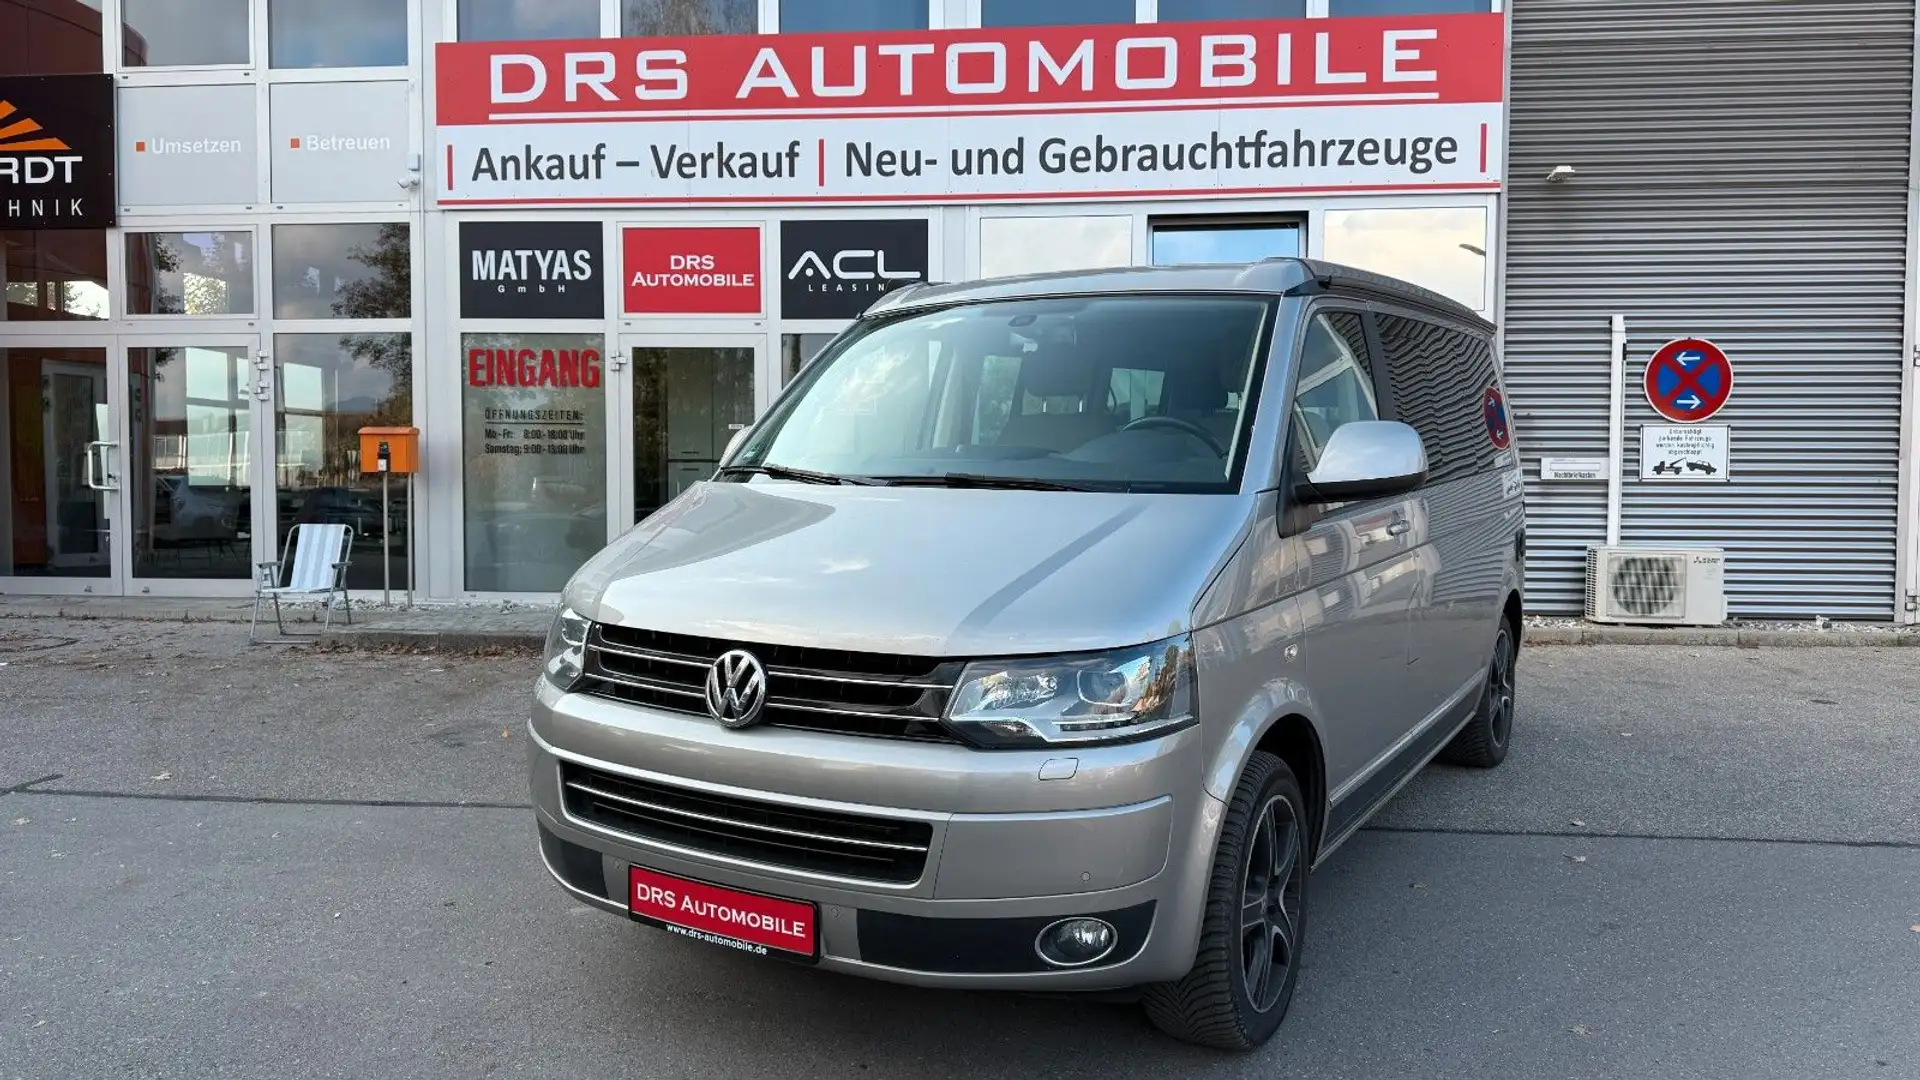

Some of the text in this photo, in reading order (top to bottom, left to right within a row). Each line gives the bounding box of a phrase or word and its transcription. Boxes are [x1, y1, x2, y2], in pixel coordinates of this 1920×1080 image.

[489, 28, 1438, 103] DRS AUTOMOBILE
[151, 136, 242, 154] Umsetzen
[306, 133, 391, 151] Betreuen
[846, 129, 1459, 177] Neu- und Gebrauchtfahrzeuge
[0, 156, 83, 184] RDT
[472, 142, 607, 181] Ankauf
[651, 140, 800, 178] Verkauf
[8, 198, 84, 217] HNIK
[472, 249, 592, 281] MATYAS
[670, 254, 715, 270] DRS
[788, 250, 921, 279] ACL
[631, 270, 755, 287] AUTOMOBILE
[808, 284, 885, 292] LEASIN
[469, 348, 600, 387] EINGANG
[636, 883, 806, 939] DRS AUTOMOBILE
[665, 923, 768, 956] www.drs-automobile.de
